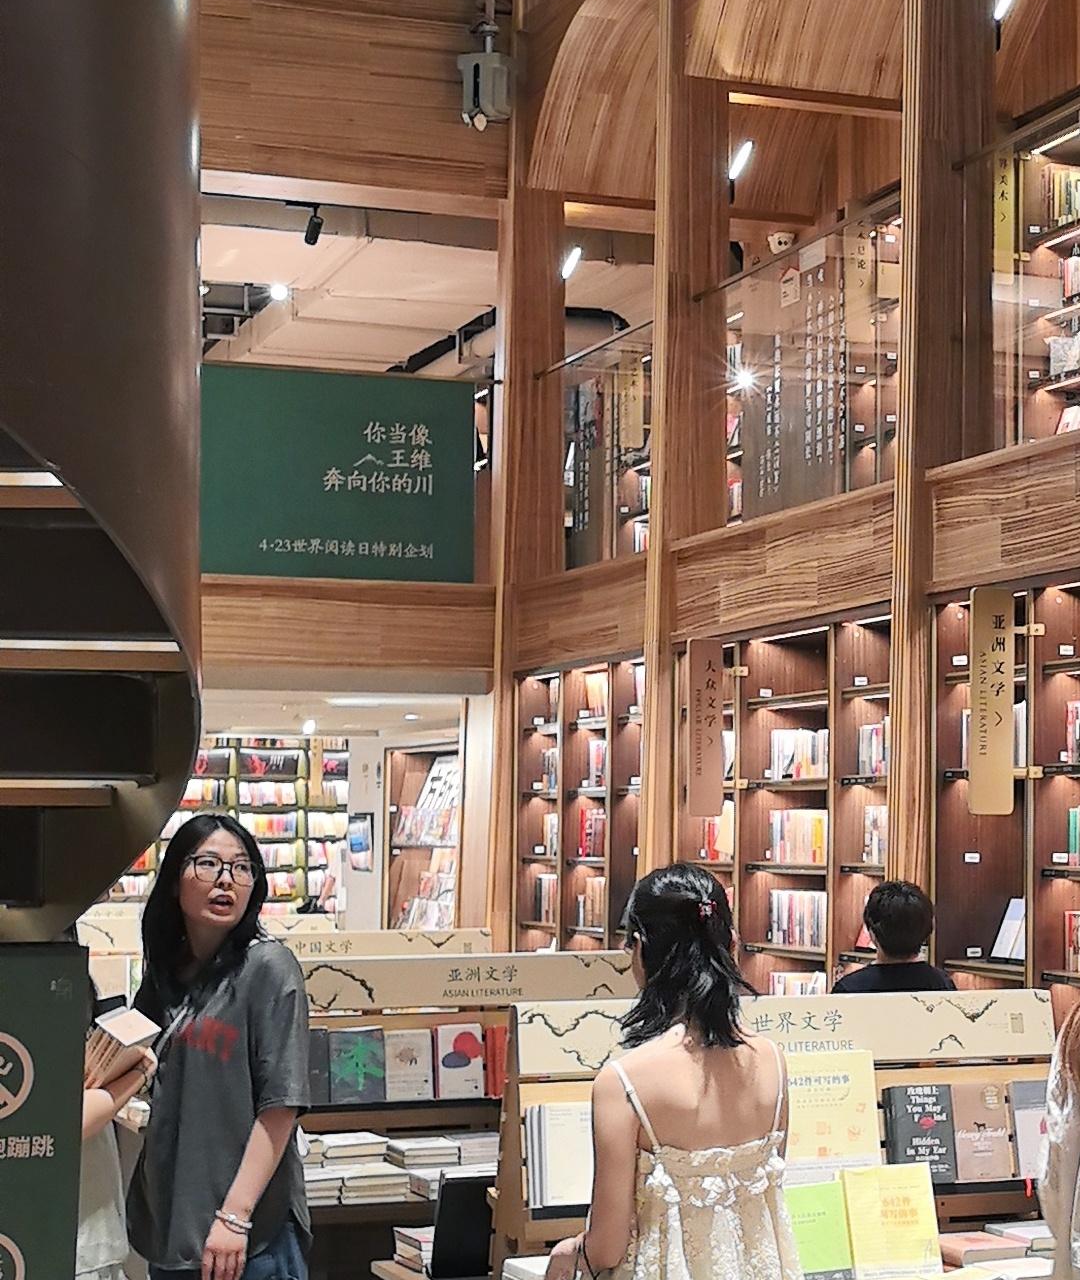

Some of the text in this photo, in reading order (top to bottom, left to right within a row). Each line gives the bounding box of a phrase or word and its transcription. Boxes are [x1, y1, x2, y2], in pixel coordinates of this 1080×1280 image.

[363, 421, 432, 446] 你当像
[386, 449, 433, 471] 王维
[323, 467, 433, 496] 奔向你的川
[990, 614, 1006, 698] 亚洲文学
[704, 659, 717, 728] 大众文学
[295, 940, 353, 955] 中国文学
[448, 964, 519, 983] 亚洲文学
[443, 987, 523, 998] ASIAN LITERATURE
[752, 1008, 843, 1034] 世界文学
[788, 1039, 855, 1052] LITERATURE
[906, 1104, 942, 1114] You May
[910, 1095, 937, 1105] Things
[0, 1135, 55, 1159] 蹦跳
[911, 1135, 941, 1146] Hidden
[917, 1146, 930, 1156] My
